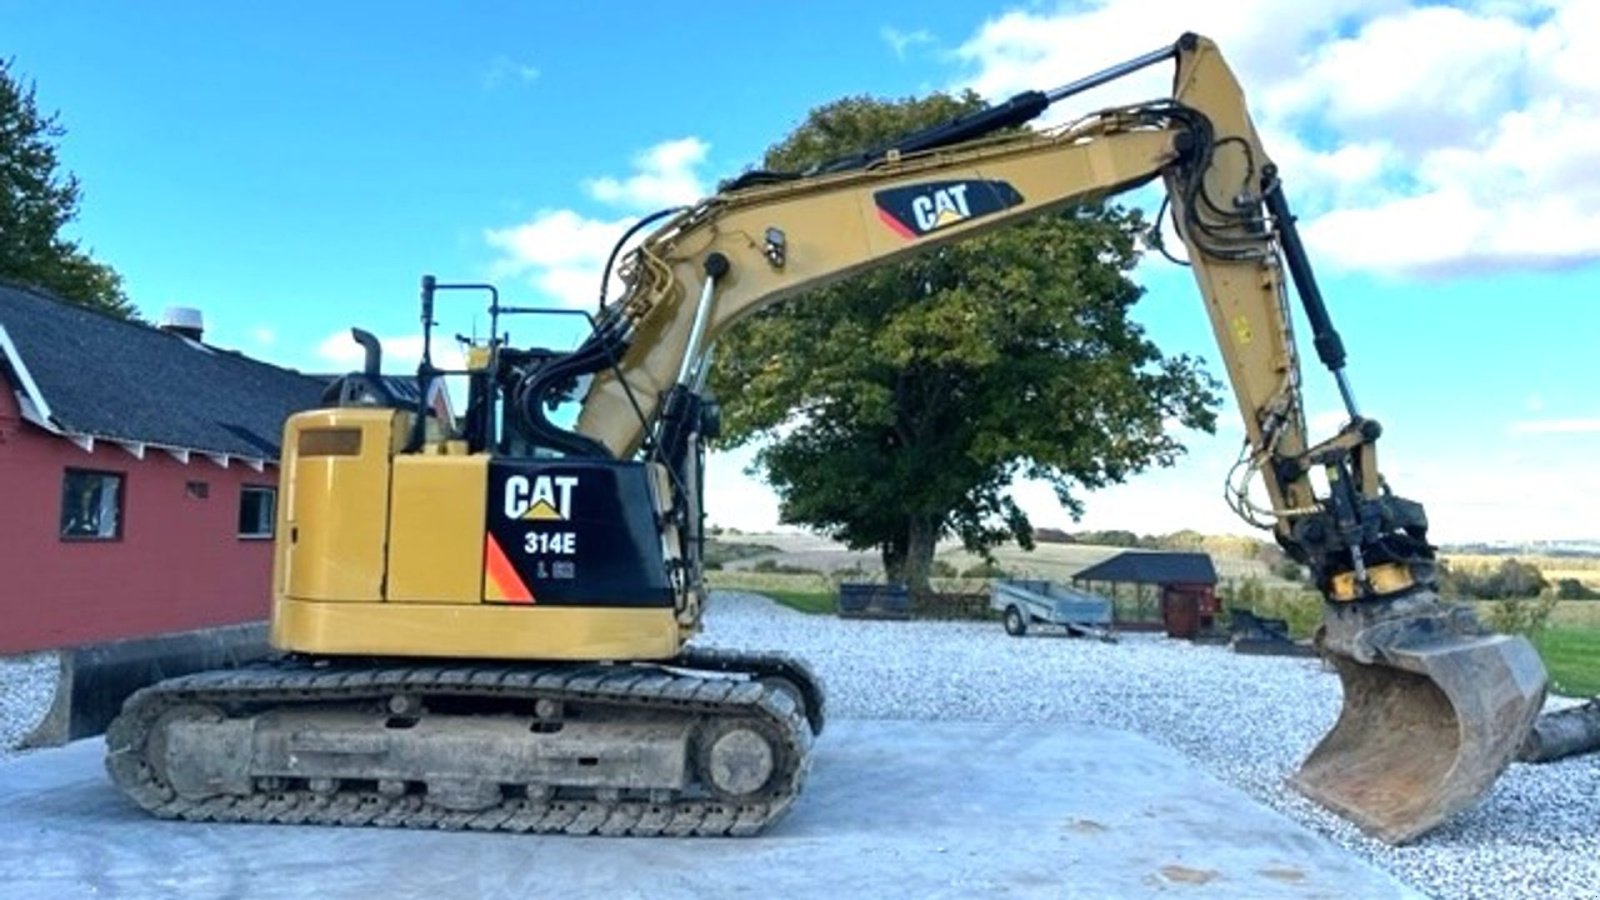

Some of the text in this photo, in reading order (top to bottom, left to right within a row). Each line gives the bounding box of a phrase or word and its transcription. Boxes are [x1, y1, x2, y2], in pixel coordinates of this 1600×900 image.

[912, 183, 971, 231] CAT
[504, 475, 578, 520] CAT
[524, 532, 576, 554] 314E
